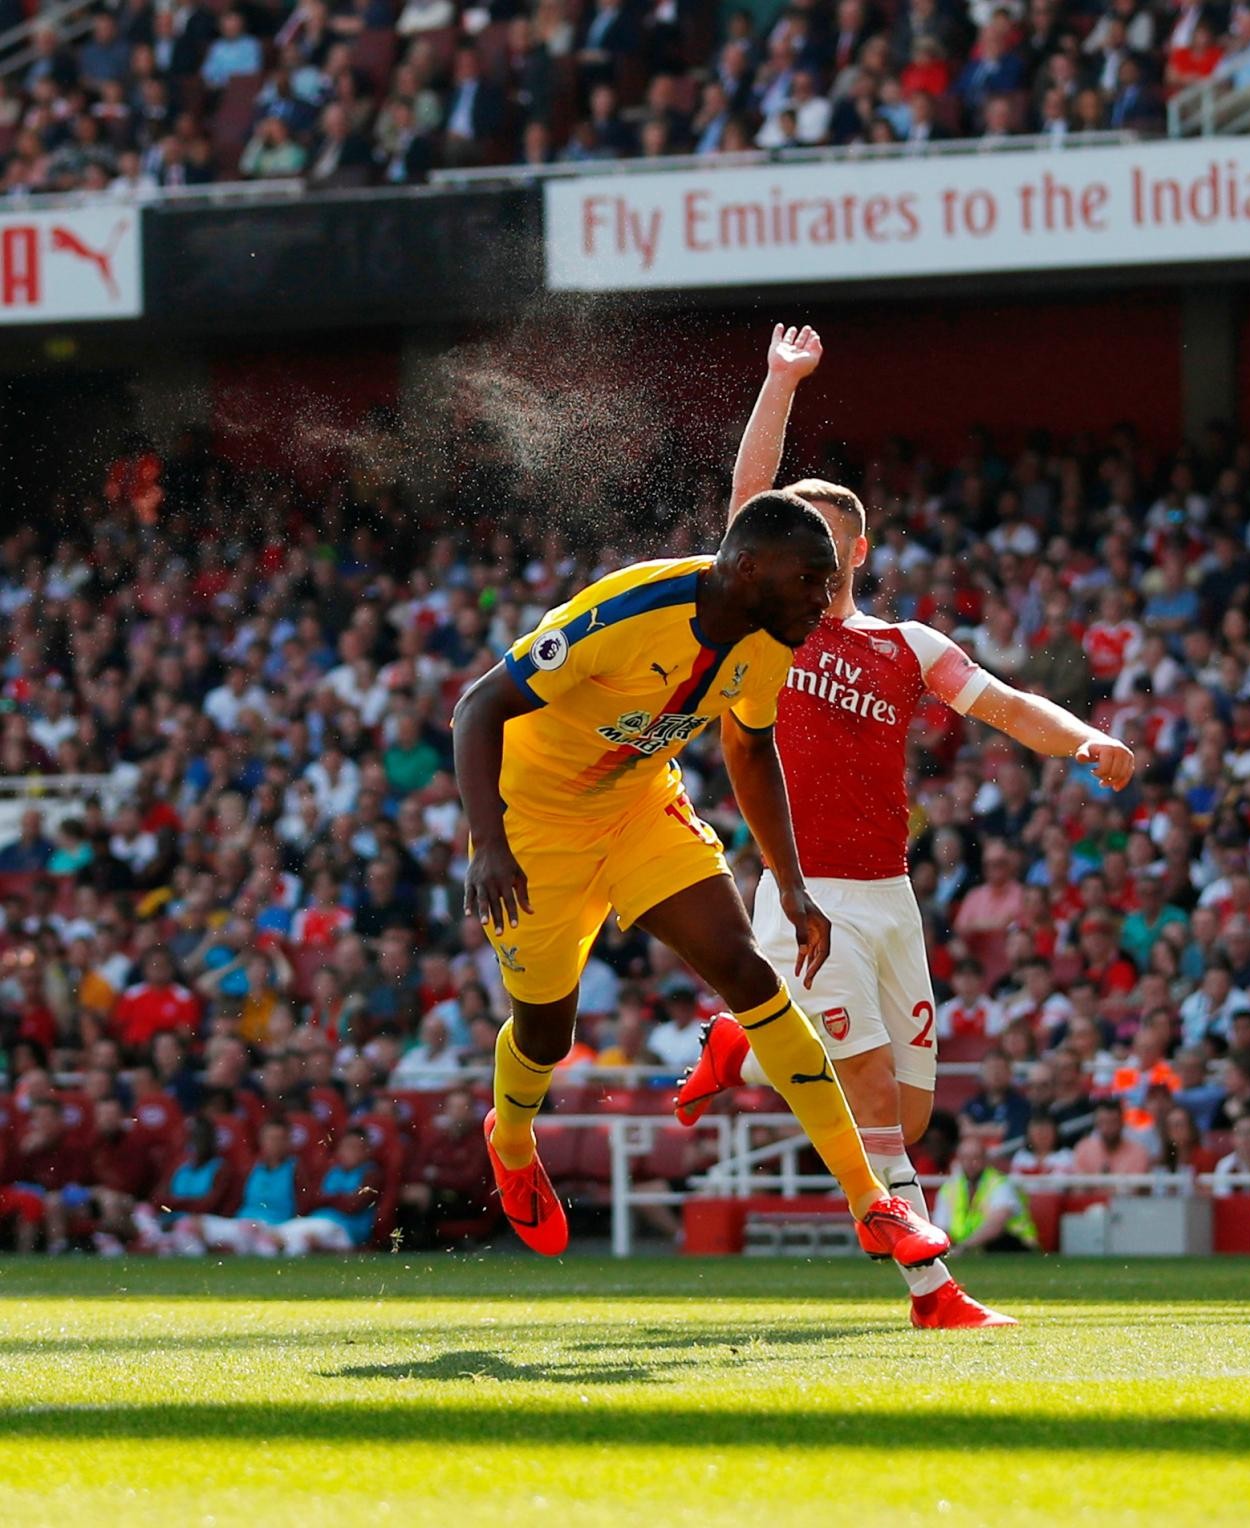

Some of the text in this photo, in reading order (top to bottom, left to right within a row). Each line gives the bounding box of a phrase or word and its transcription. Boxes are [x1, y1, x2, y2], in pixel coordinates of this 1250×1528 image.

[582, 194, 662, 269] Fly
[683, 187, 921, 252] Emirates
[940, 188, 998, 238] to
[1017, 171, 1109, 234] the
[819, 651, 862, 685] Fly
[786, 666, 897, 726] mirates
[911, 1000, 934, 1049] 2
